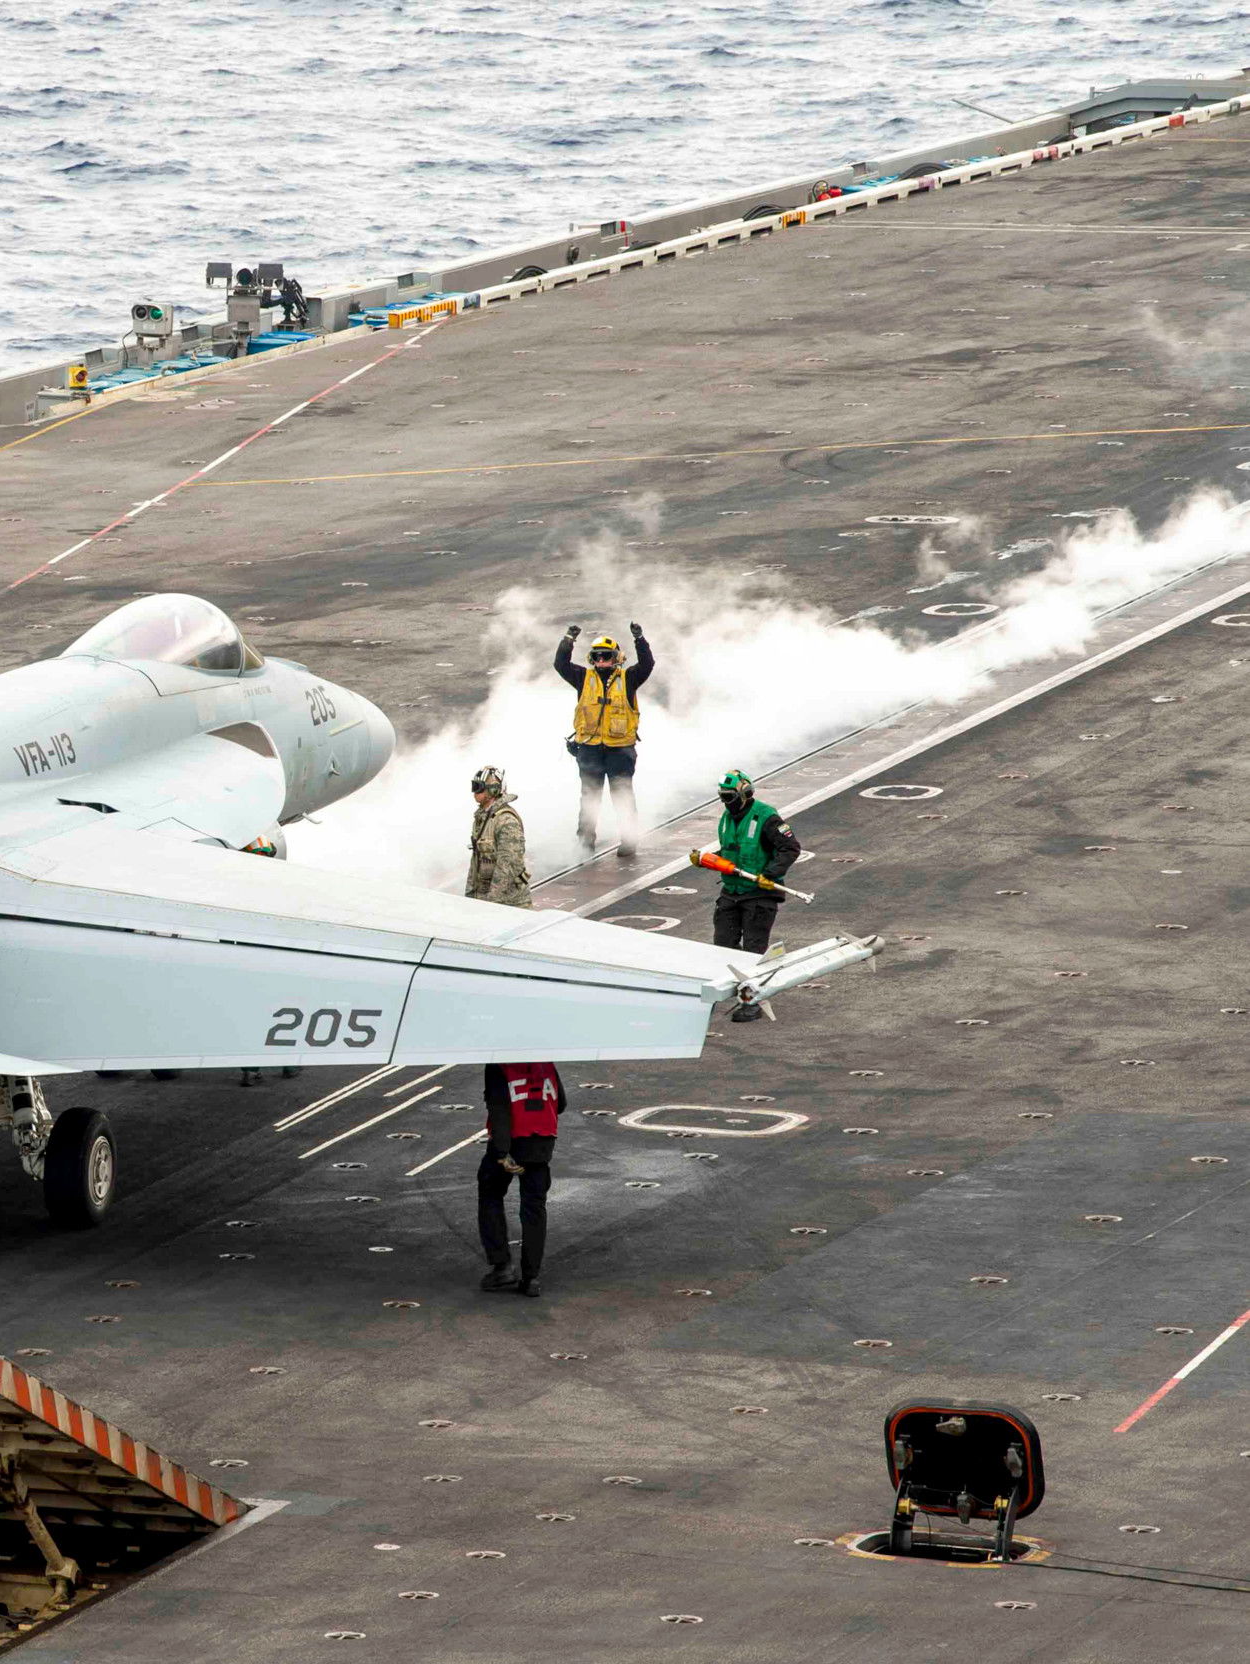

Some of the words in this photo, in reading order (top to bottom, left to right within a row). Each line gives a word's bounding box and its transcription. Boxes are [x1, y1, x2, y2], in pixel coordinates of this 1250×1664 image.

[305, 686, 336, 726] 205
[14, 733, 76, 776] VFA-113
[264, 1007, 382, 1048] 205
